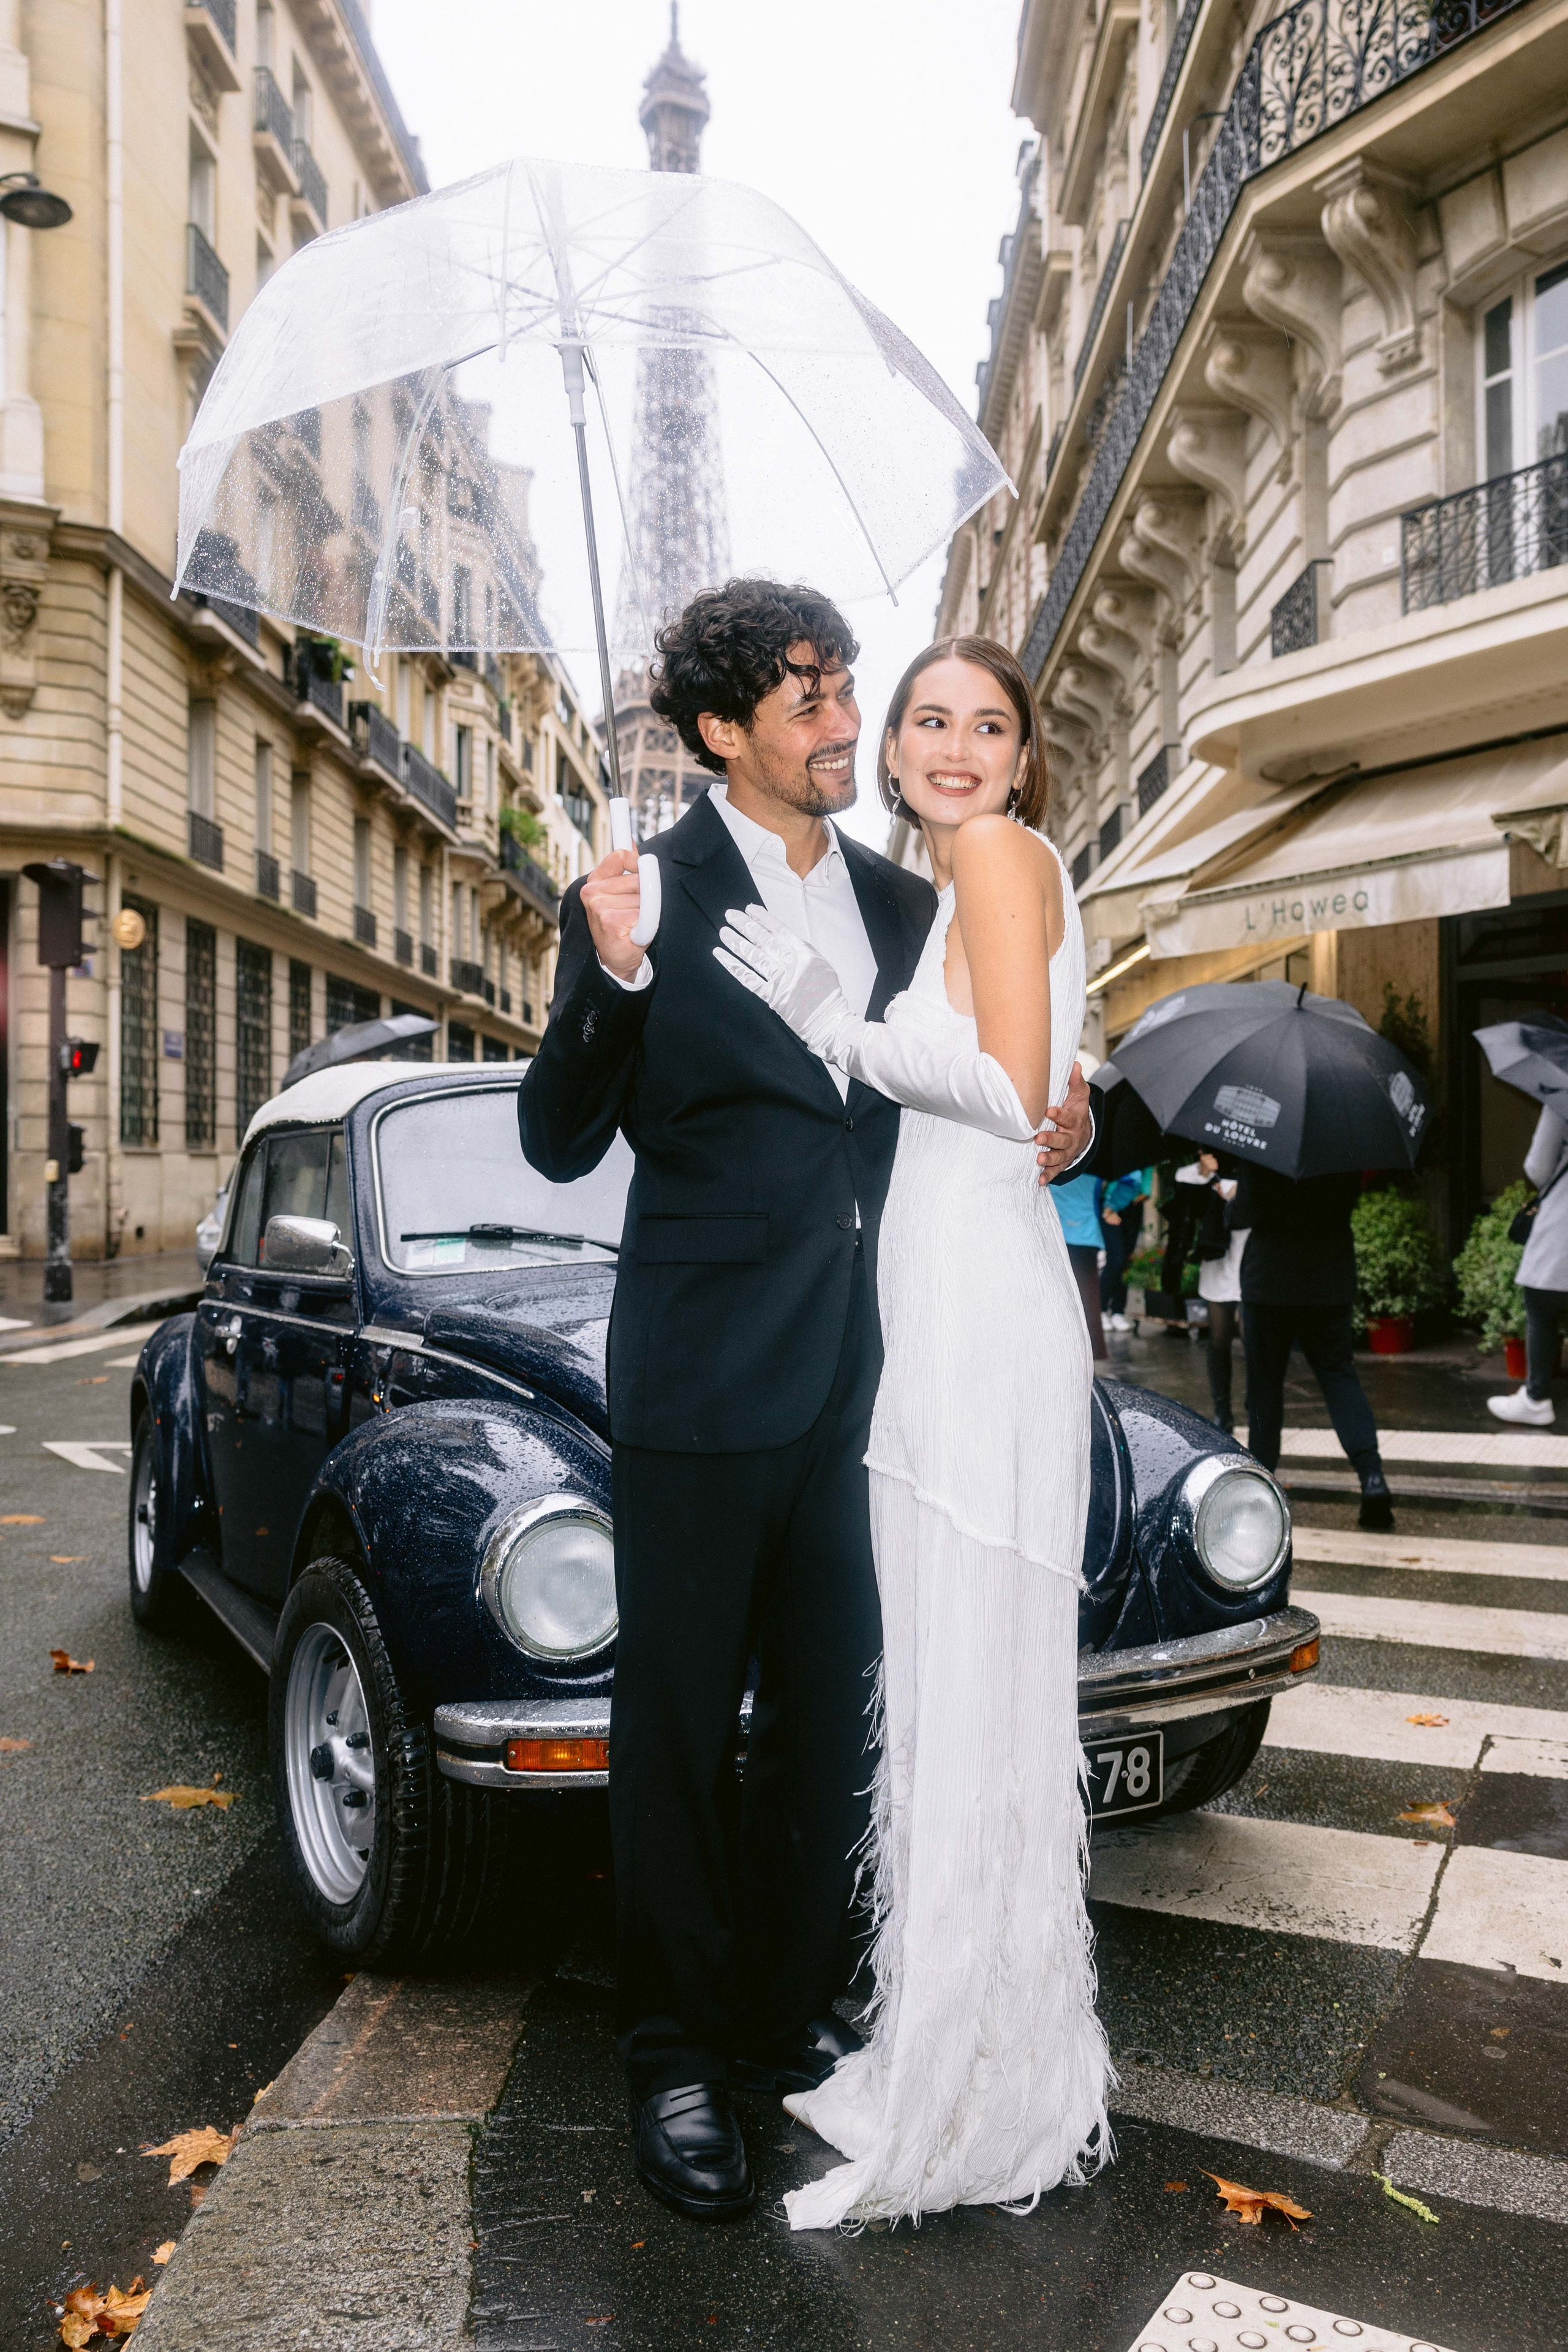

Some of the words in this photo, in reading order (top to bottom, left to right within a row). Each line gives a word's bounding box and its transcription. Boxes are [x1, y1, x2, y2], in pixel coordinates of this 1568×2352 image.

[1245, 891, 1369, 930] L'Howea
[1204, 1122, 1221, 1134] DU
[1224, 1128, 1268, 1150] LOUVRE
[1221, 1119, 1256, 1137] HÔTEL
[1097, 1747, 1150, 1803] 78
